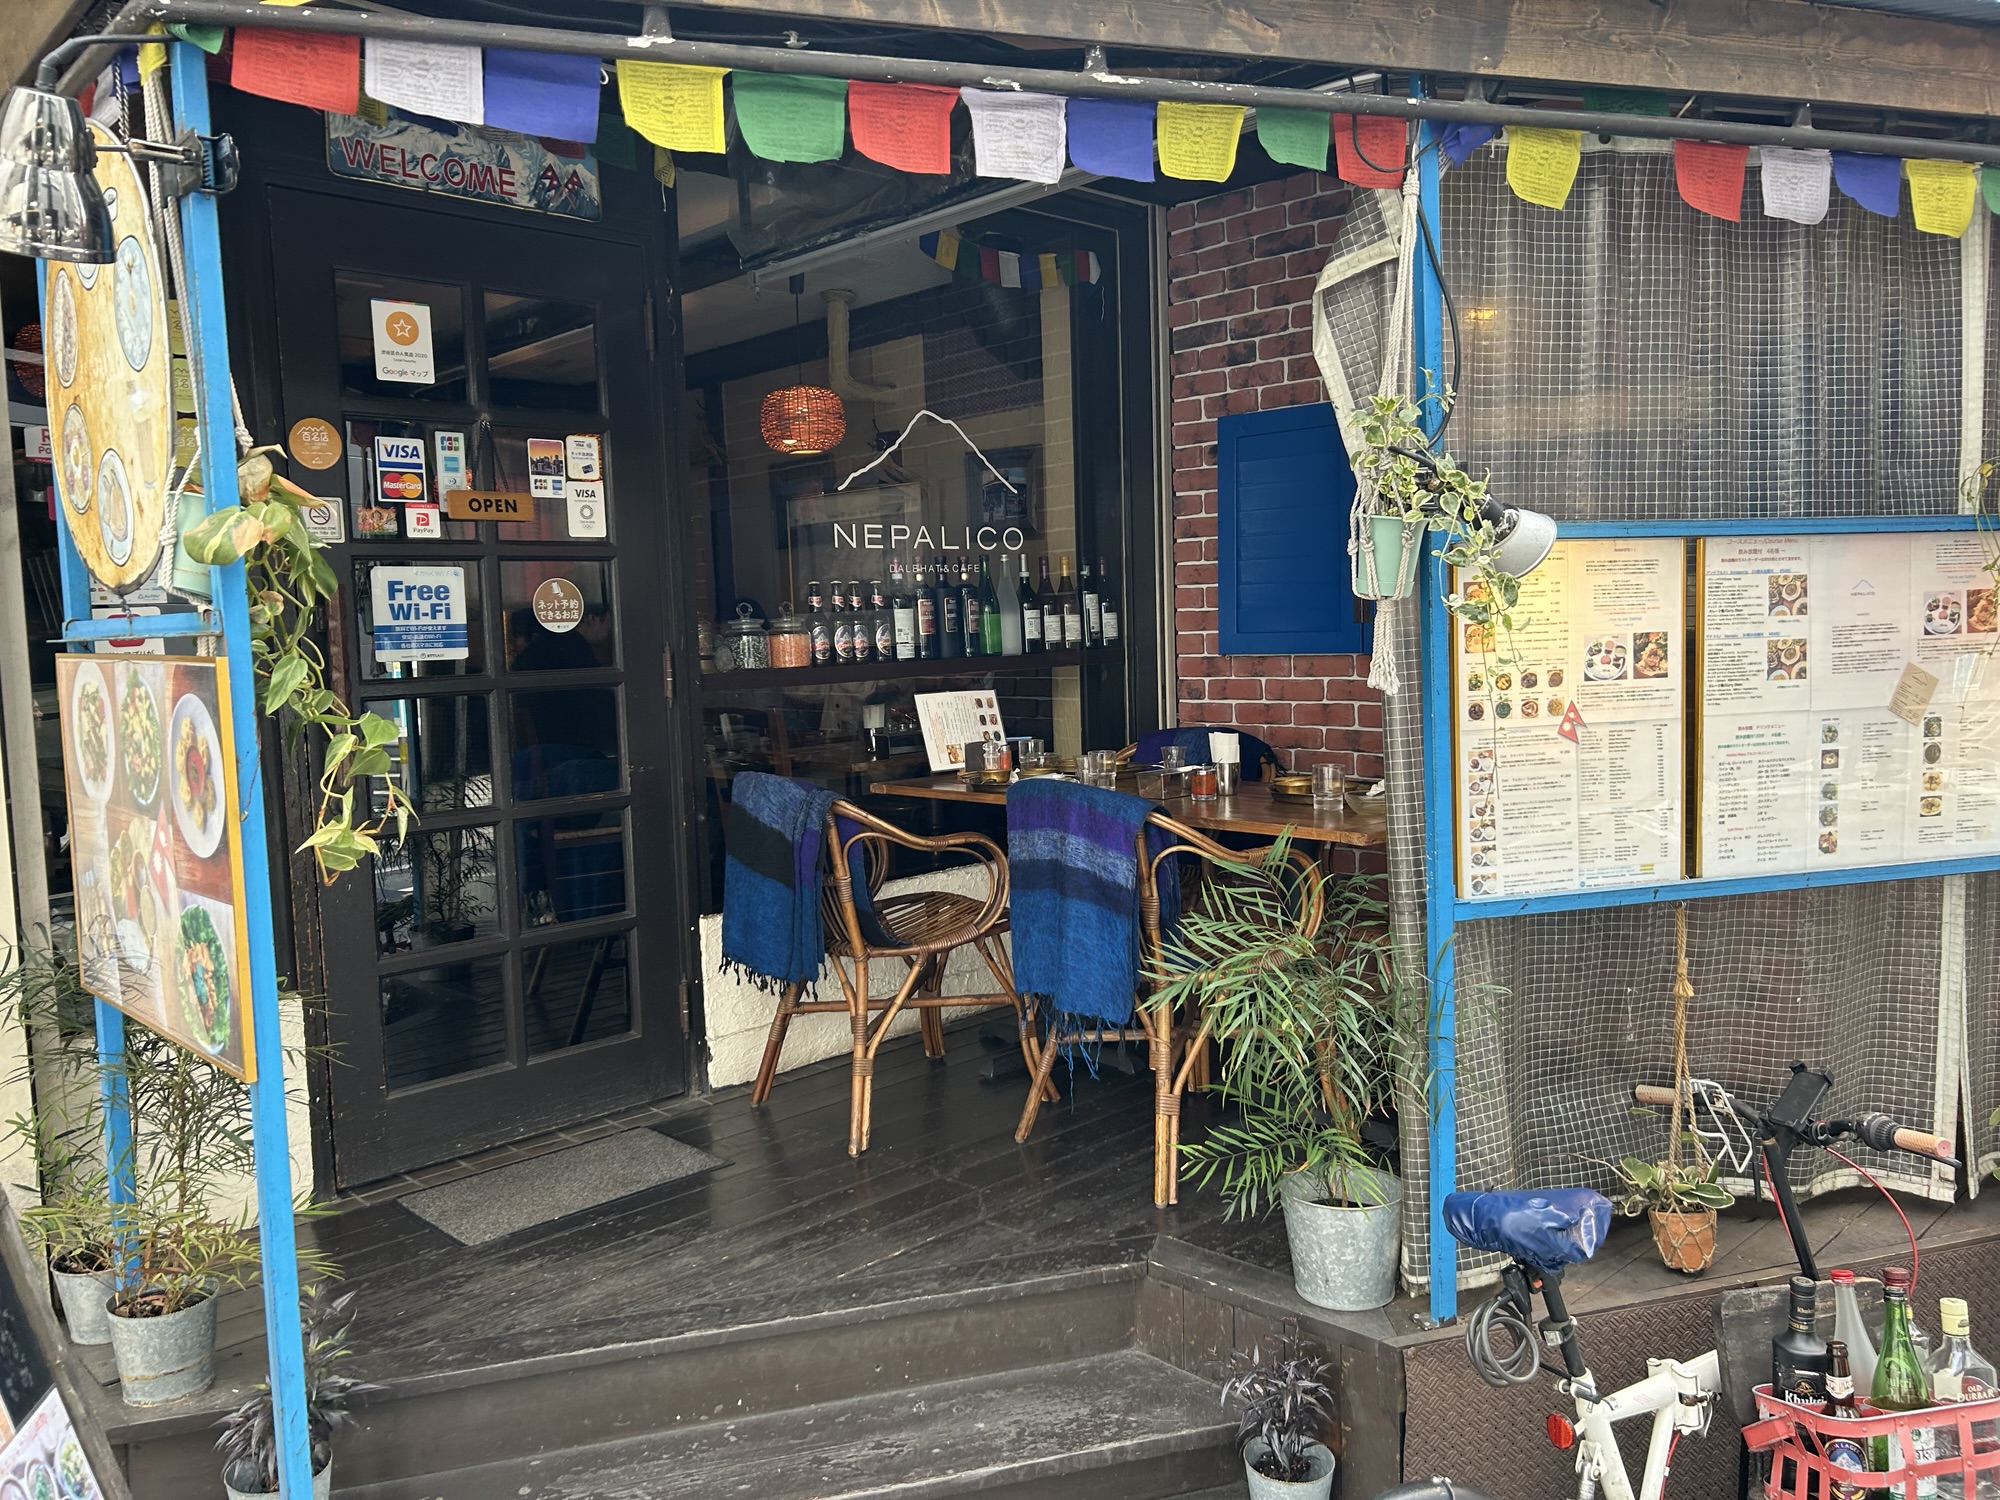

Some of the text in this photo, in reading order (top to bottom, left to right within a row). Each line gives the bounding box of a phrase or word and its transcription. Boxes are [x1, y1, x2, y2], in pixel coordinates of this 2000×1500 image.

[341, 136, 518, 198] WELCOME
[382, 366, 409, 377] Google
[302, 431, 329, 442] 百名店
[382, 444, 420, 459] VISA
[383, 481, 422, 490] MasterCard
[574, 489, 596, 498] VISA
[468, 498, 518, 513] OPEN
[833, 523, 1024, 550] NEPALICO
[889, 564, 942, 573] DALBHAT
[952, 564, 980, 573] CAFE
[387, 580, 450, 601] Free
[538, 599, 579, 610] ネット予約
[388, 603, 451, 620] Wi-Fi
[538, 609, 580, 620] できるお店
[1957, 1389, 1995, 1403] DURBAR
